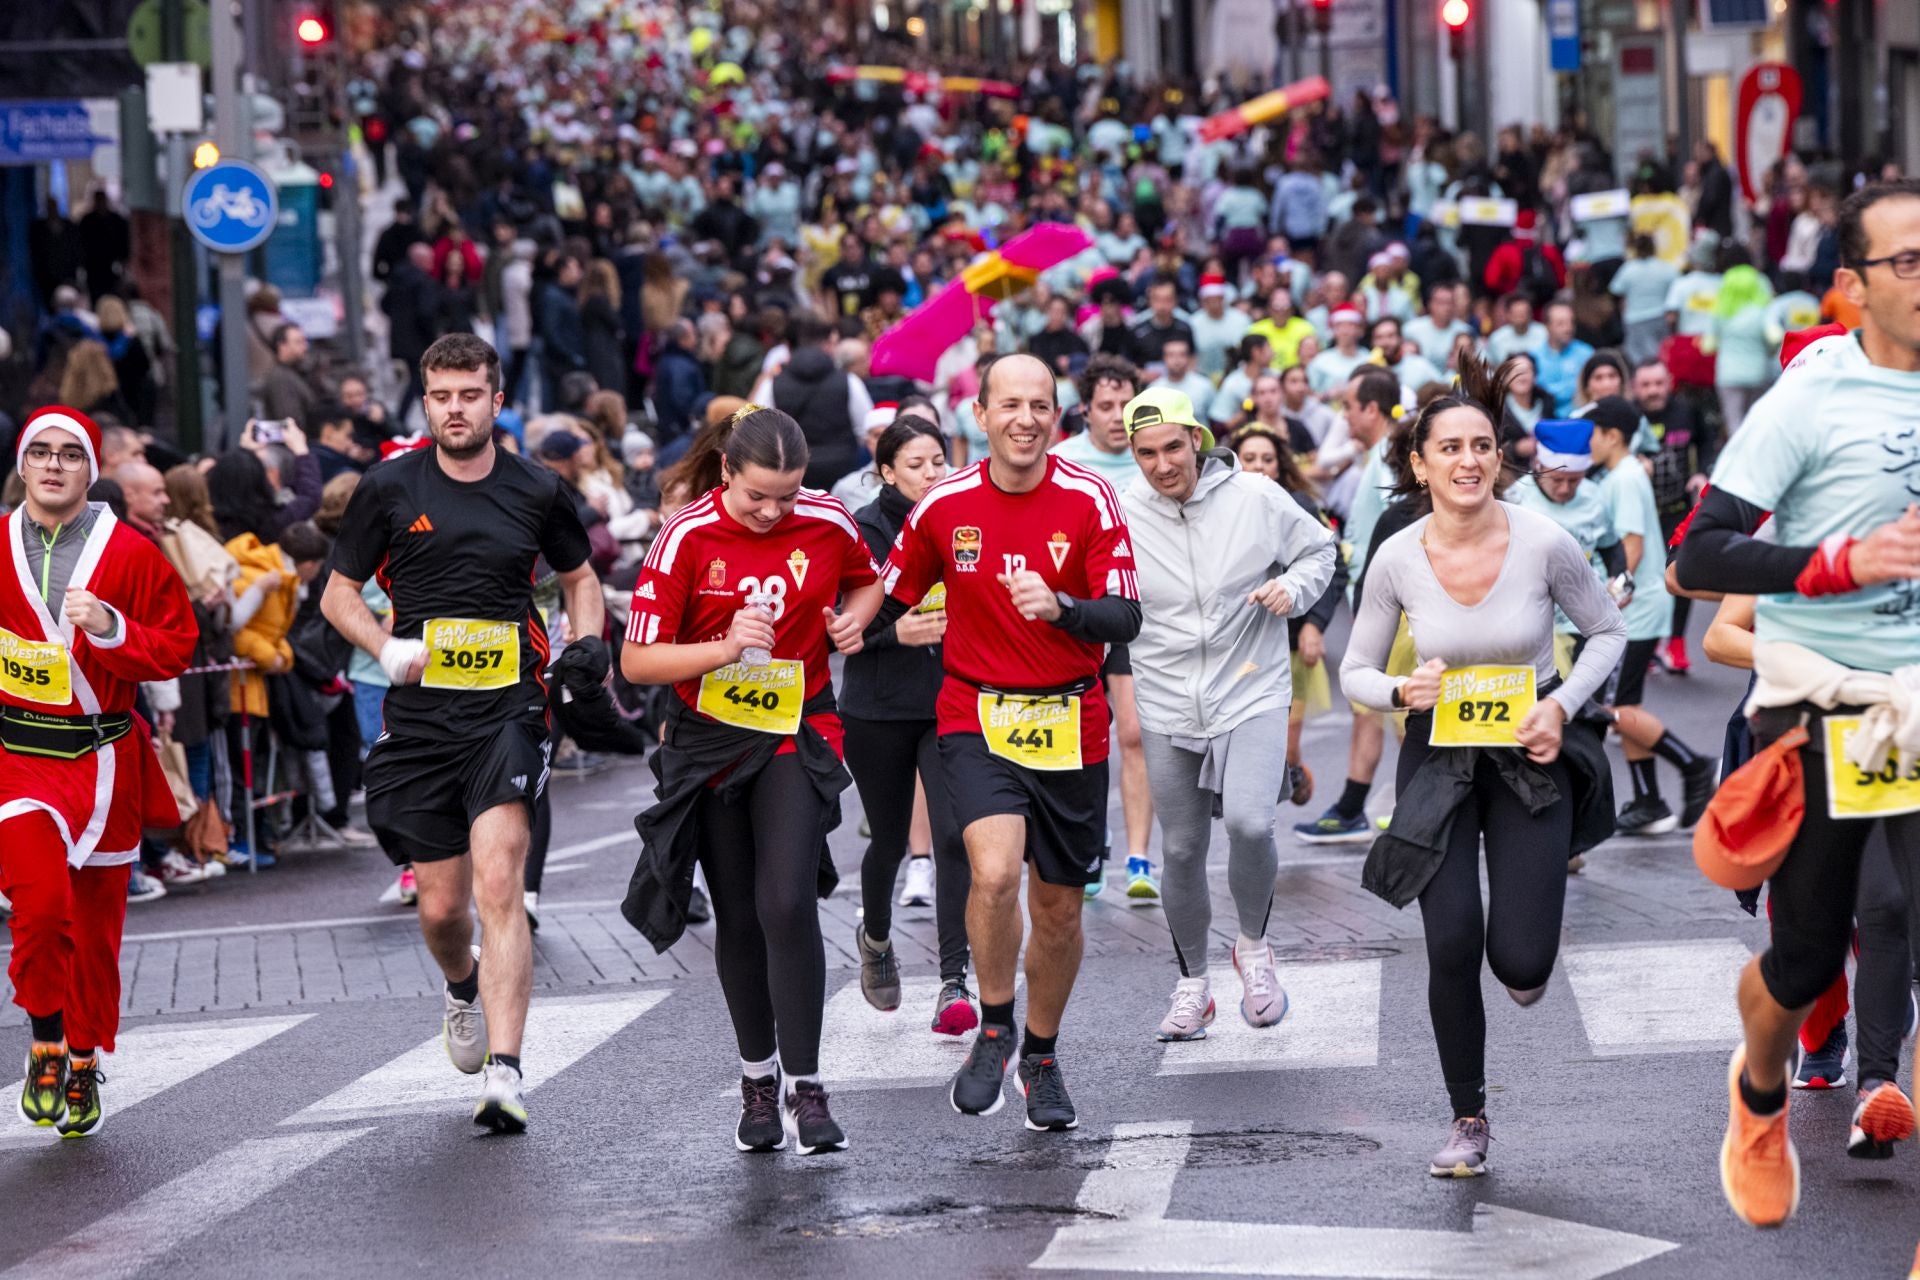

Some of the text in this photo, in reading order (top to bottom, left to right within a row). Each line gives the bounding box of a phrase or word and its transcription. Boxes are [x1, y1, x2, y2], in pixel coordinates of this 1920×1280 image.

[434, 623, 511, 650] SILVESTRE
[436, 623, 467, 638] SAN
[0, 636, 18, 648] AN
[481, 636, 511, 648] MURCIA
[0, 646, 59, 660] ILVESTRE
[441, 649, 503, 669] 3057
[2, 657, 51, 686] 1935
[714, 666, 795, 683] SILVESTRE
[1445, 671, 1476, 689] SAN
[761, 680, 796, 690] MURCIA
[1443, 672, 1527, 705] SILVESTRE
[1492, 687, 1525, 699] MURCIA
[724, 685, 779, 710] 440
[989, 704, 1070, 728] SILVESTRE
[990, 702, 1022, 716] SAN
[1458, 701, 1510, 722] 872
[1037, 715, 1070, 727] MURCIA
[1006, 728, 1053, 748] 441
